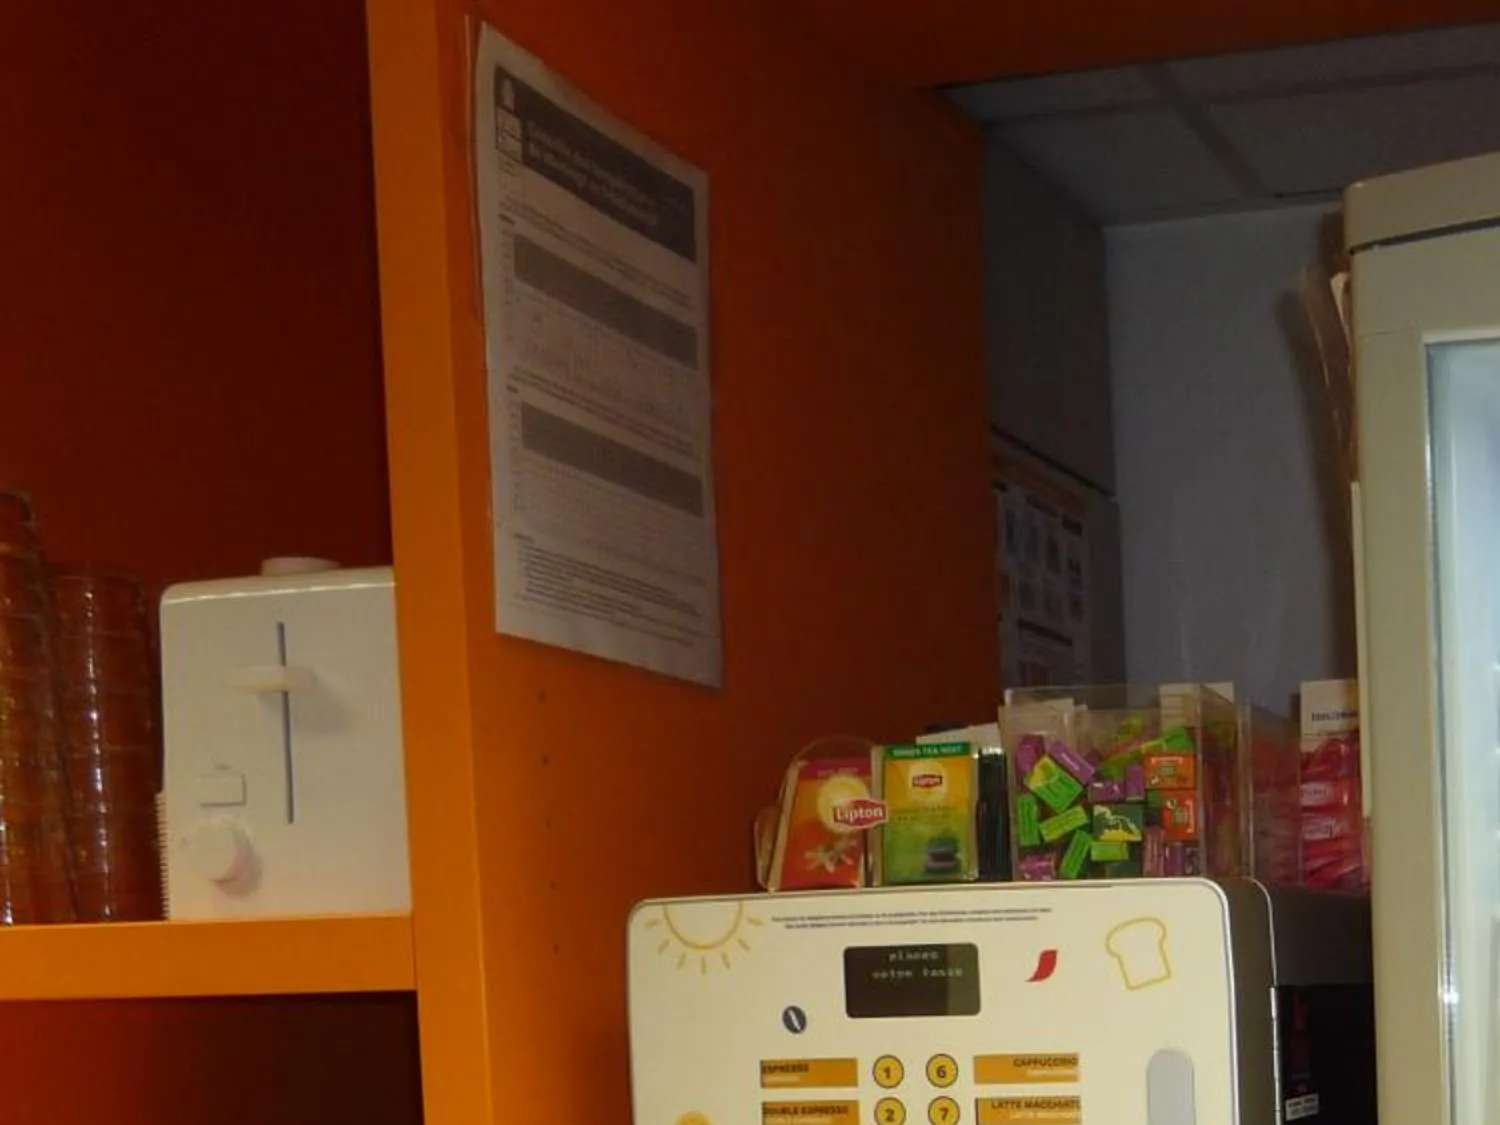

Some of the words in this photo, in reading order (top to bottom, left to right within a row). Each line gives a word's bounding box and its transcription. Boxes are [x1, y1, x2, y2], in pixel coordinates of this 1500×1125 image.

[836, 804, 884, 822] Lipton
[883, 1066, 892, 1079] 1
[936, 1065, 946, 1078] 6
[885, 1108, 895, 1122] 2
[939, 1107, 949, 1121] 7
